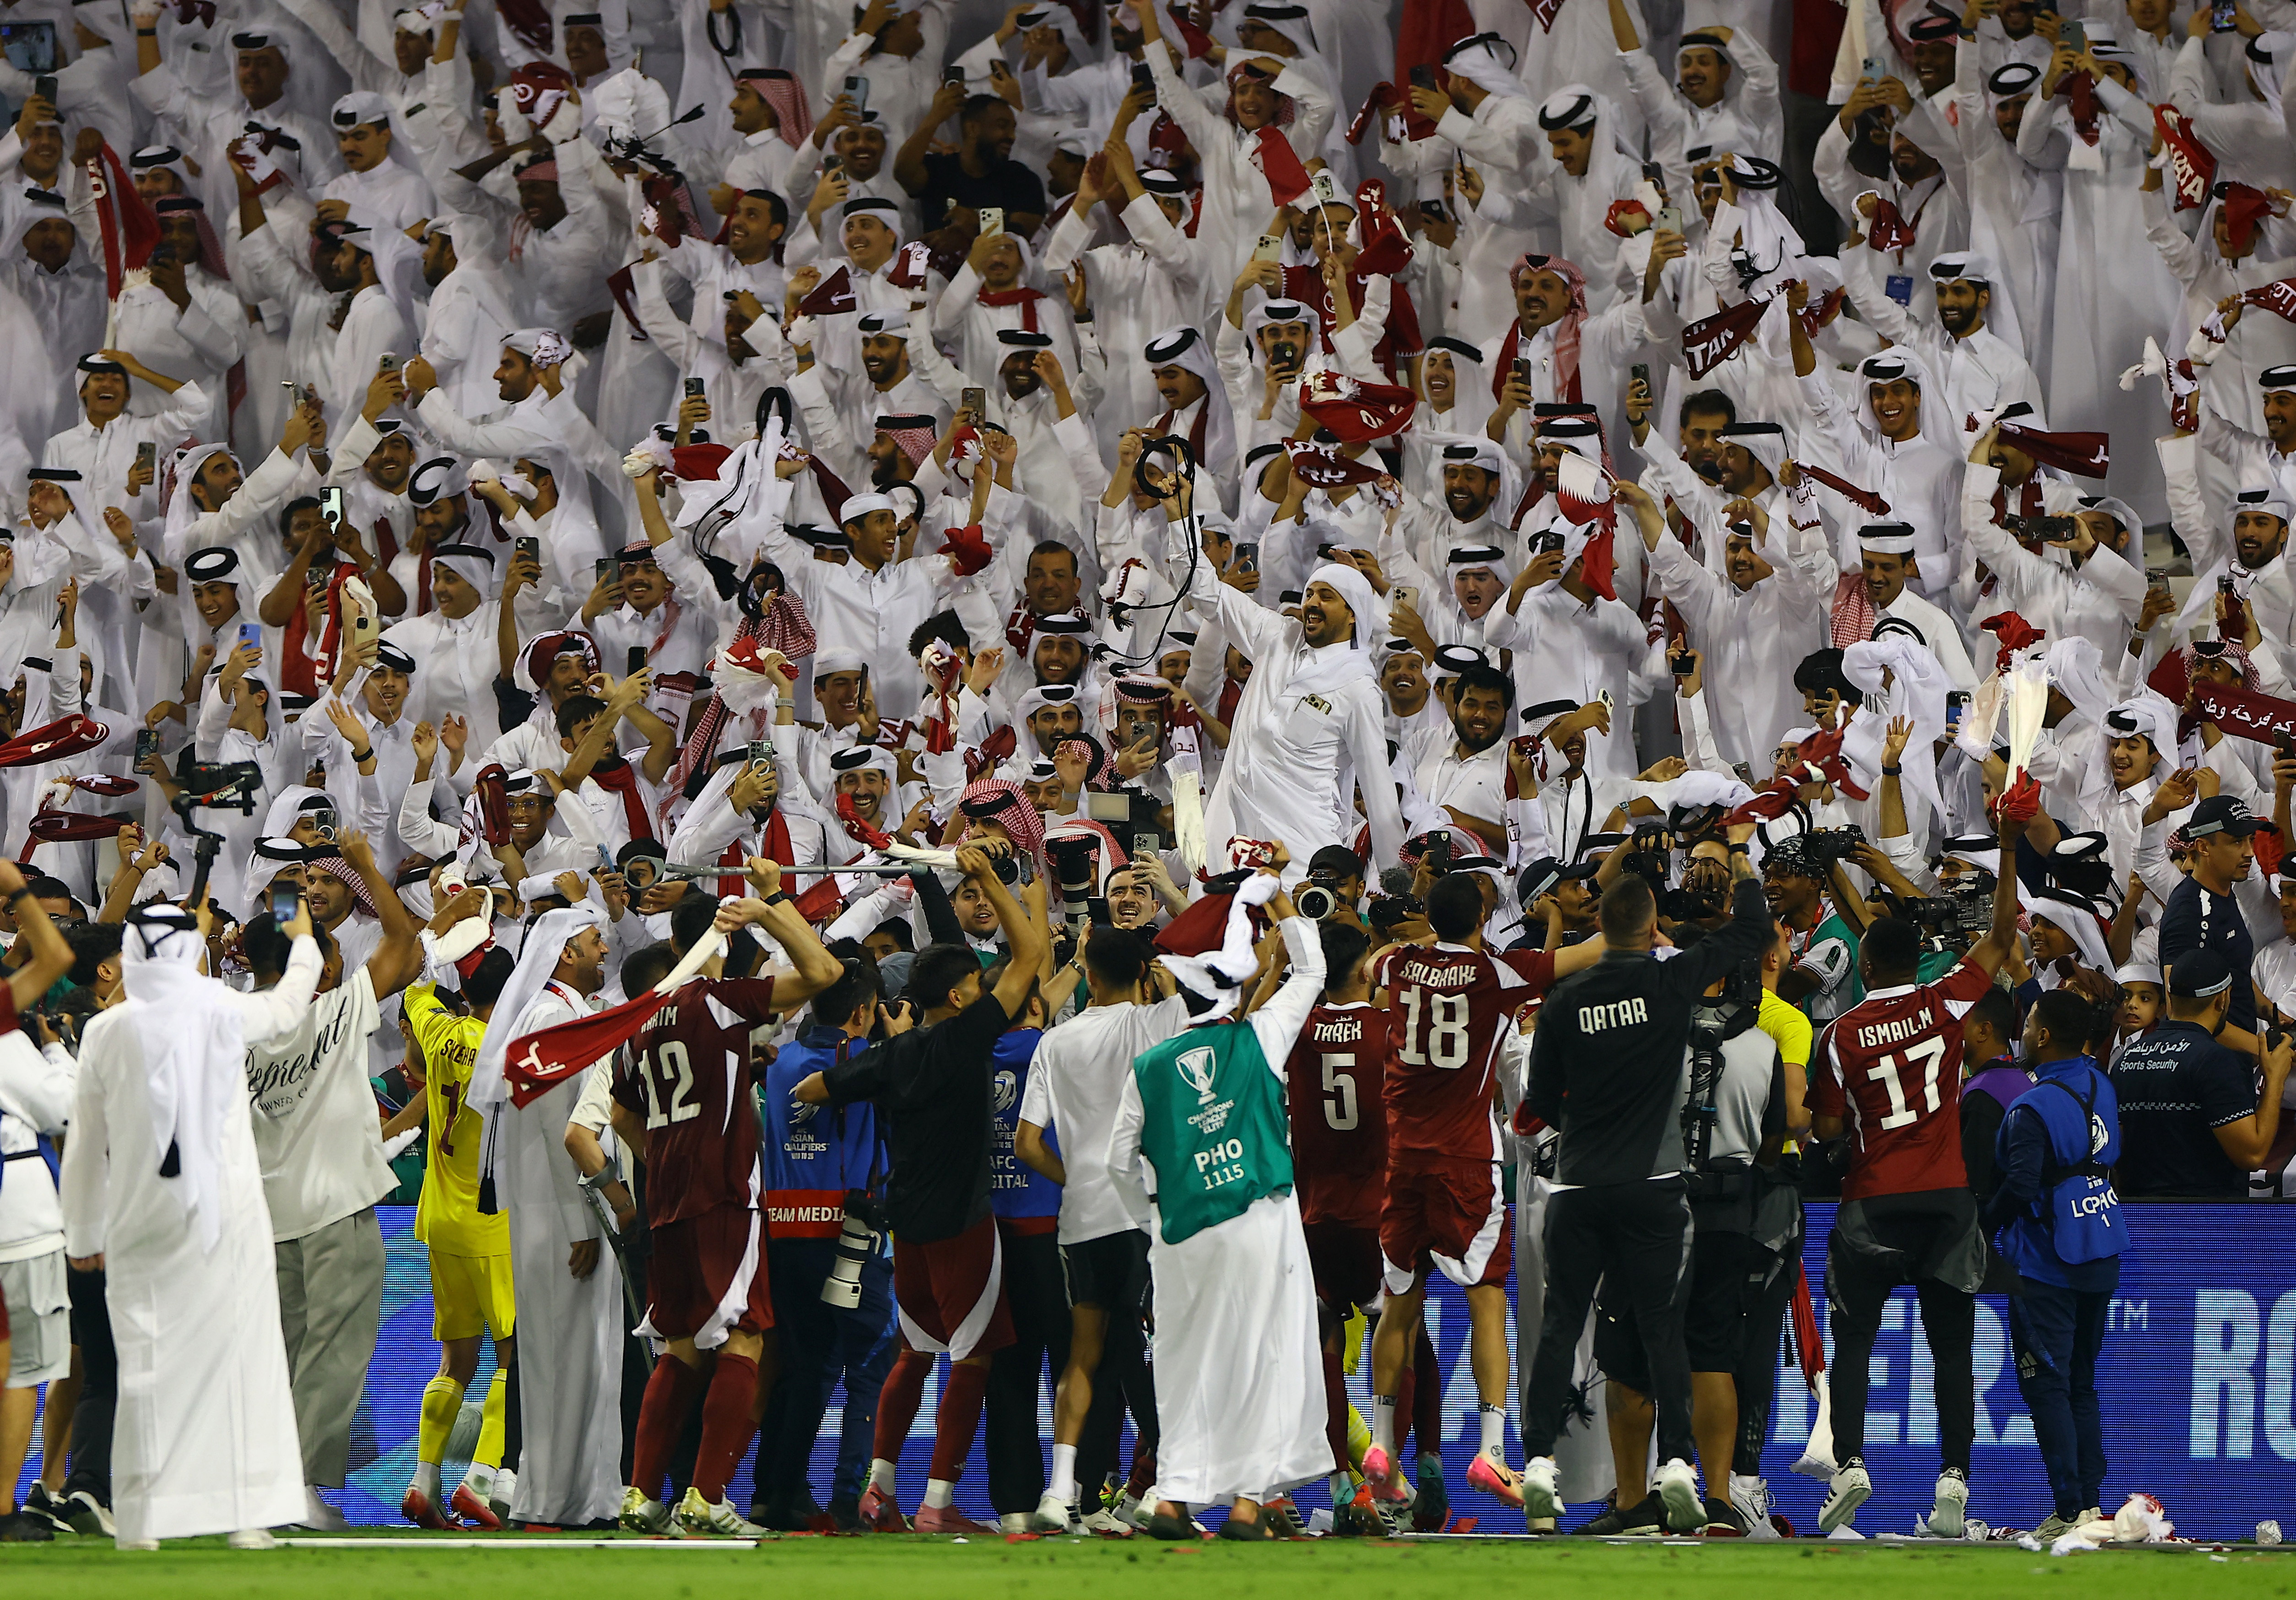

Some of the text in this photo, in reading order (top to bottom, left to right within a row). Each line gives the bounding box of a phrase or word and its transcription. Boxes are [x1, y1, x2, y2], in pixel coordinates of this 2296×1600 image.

[2231, 705, 2274, 728] فرحة
[212, 786, 237, 802] RONIN
[1398, 985, 1470, 1069] 18
[1579, 997, 1648, 1035] QATAR
[1857, 1006, 1934, 1048] ISMAIL.M
[1313, 1020, 1362, 1043] TAREK
[440, 1038, 477, 1067] SHEHA
[2124, 1038, 2191, 1060] الأمن الرياضي
[2119, 1058, 2179, 1072] Sports Security
[638, 1041, 702, 1131] 12
[1321, 1053, 1359, 1130] 5
[1867, 1034, 1946, 1130] 17
[790, 1134, 815, 1142] ASIAN
[1194, 1138, 1243, 1173] PHO
[1203, 1163, 1245, 1190] 1115
[768, 1206, 847, 1222] TEAM MEDIA
[2101, 1213, 2111, 1227] 1
